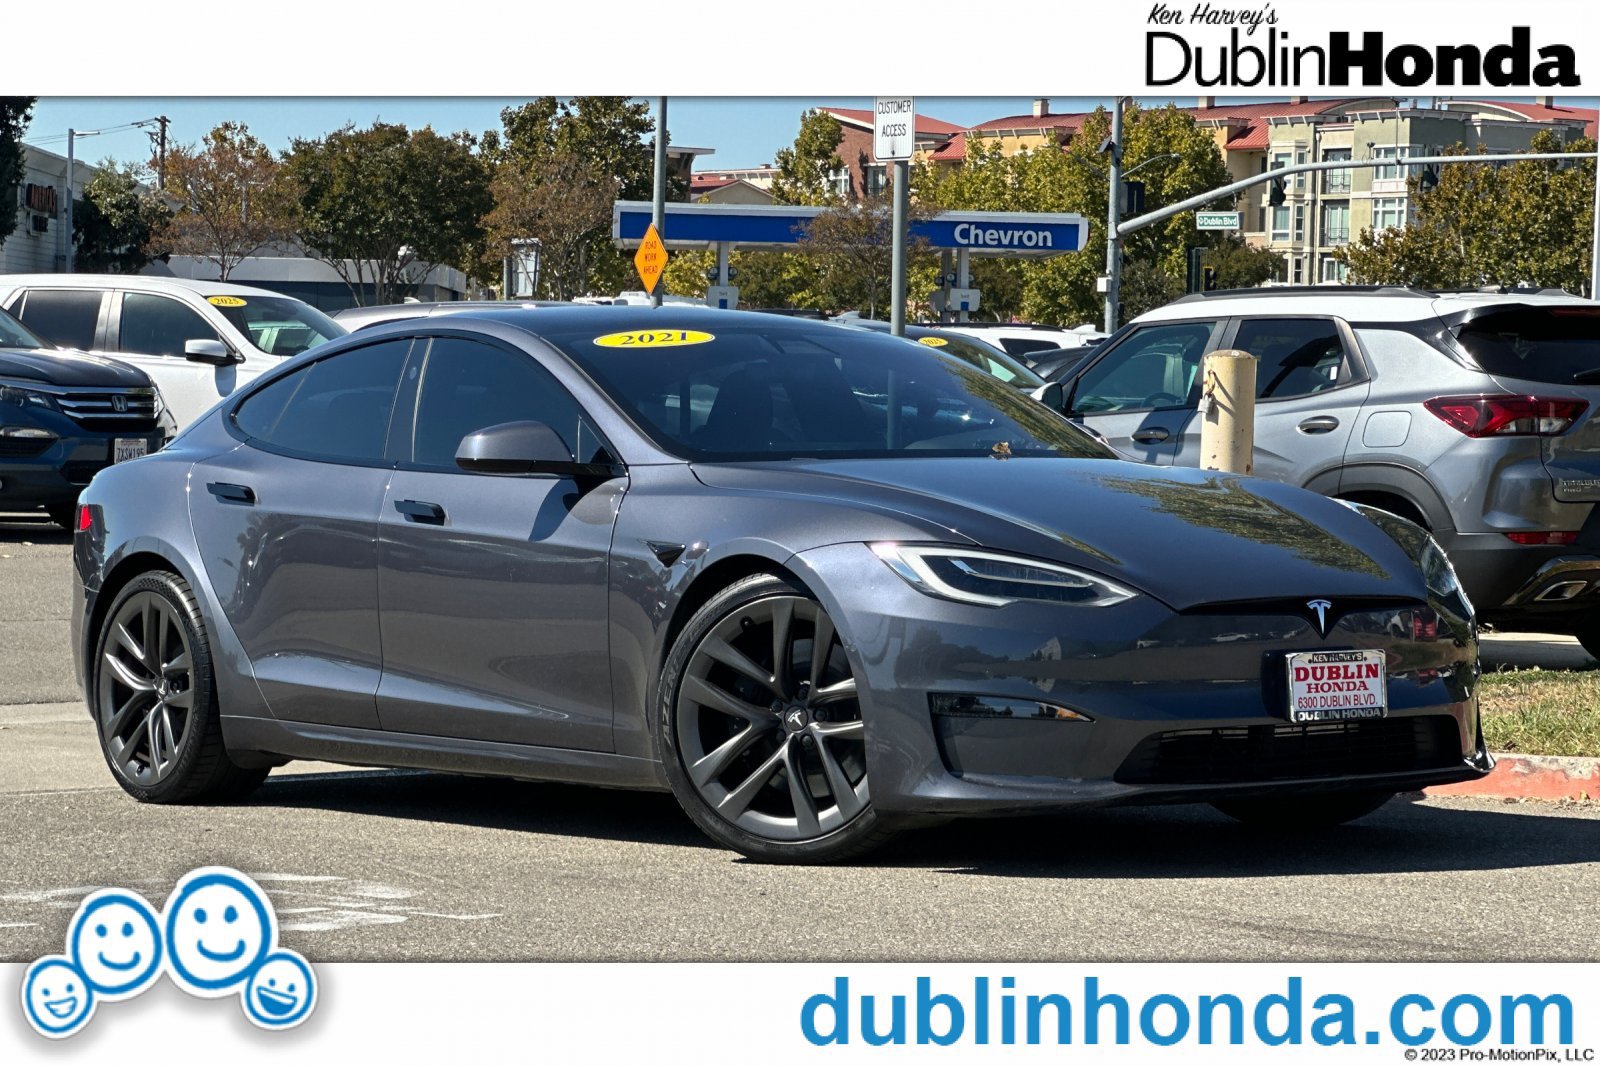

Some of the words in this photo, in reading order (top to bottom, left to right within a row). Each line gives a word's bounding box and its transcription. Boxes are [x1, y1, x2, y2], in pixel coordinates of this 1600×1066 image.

[878, 100, 912, 114] CUSTOMER
[882, 123, 907, 137] ACCESS
[1203, 216, 1223, 226] Dublin
[1223, 216, 1237, 226] Blvd
[954, 223, 1052, 247] Chevron
[645, 240, 657, 250] ROAD
[644, 253, 657, 262] WORK
[643, 265, 658, 274] AHEAD
[619, 331, 687, 345] 2021
[1313, 654, 1328, 662] KEN
[1295, 663, 1379, 681] DUBLIN
[1306, 681, 1369, 693] HONDA
[1298, 696, 1318, 709] 6300
[1320, 695, 1351, 708] DUBLIN
[1354, 694, 1378, 706] BLVD.
[1297, 710, 1340, 721] DUBLIN
[1342, 708, 1381, 719] HONDA
